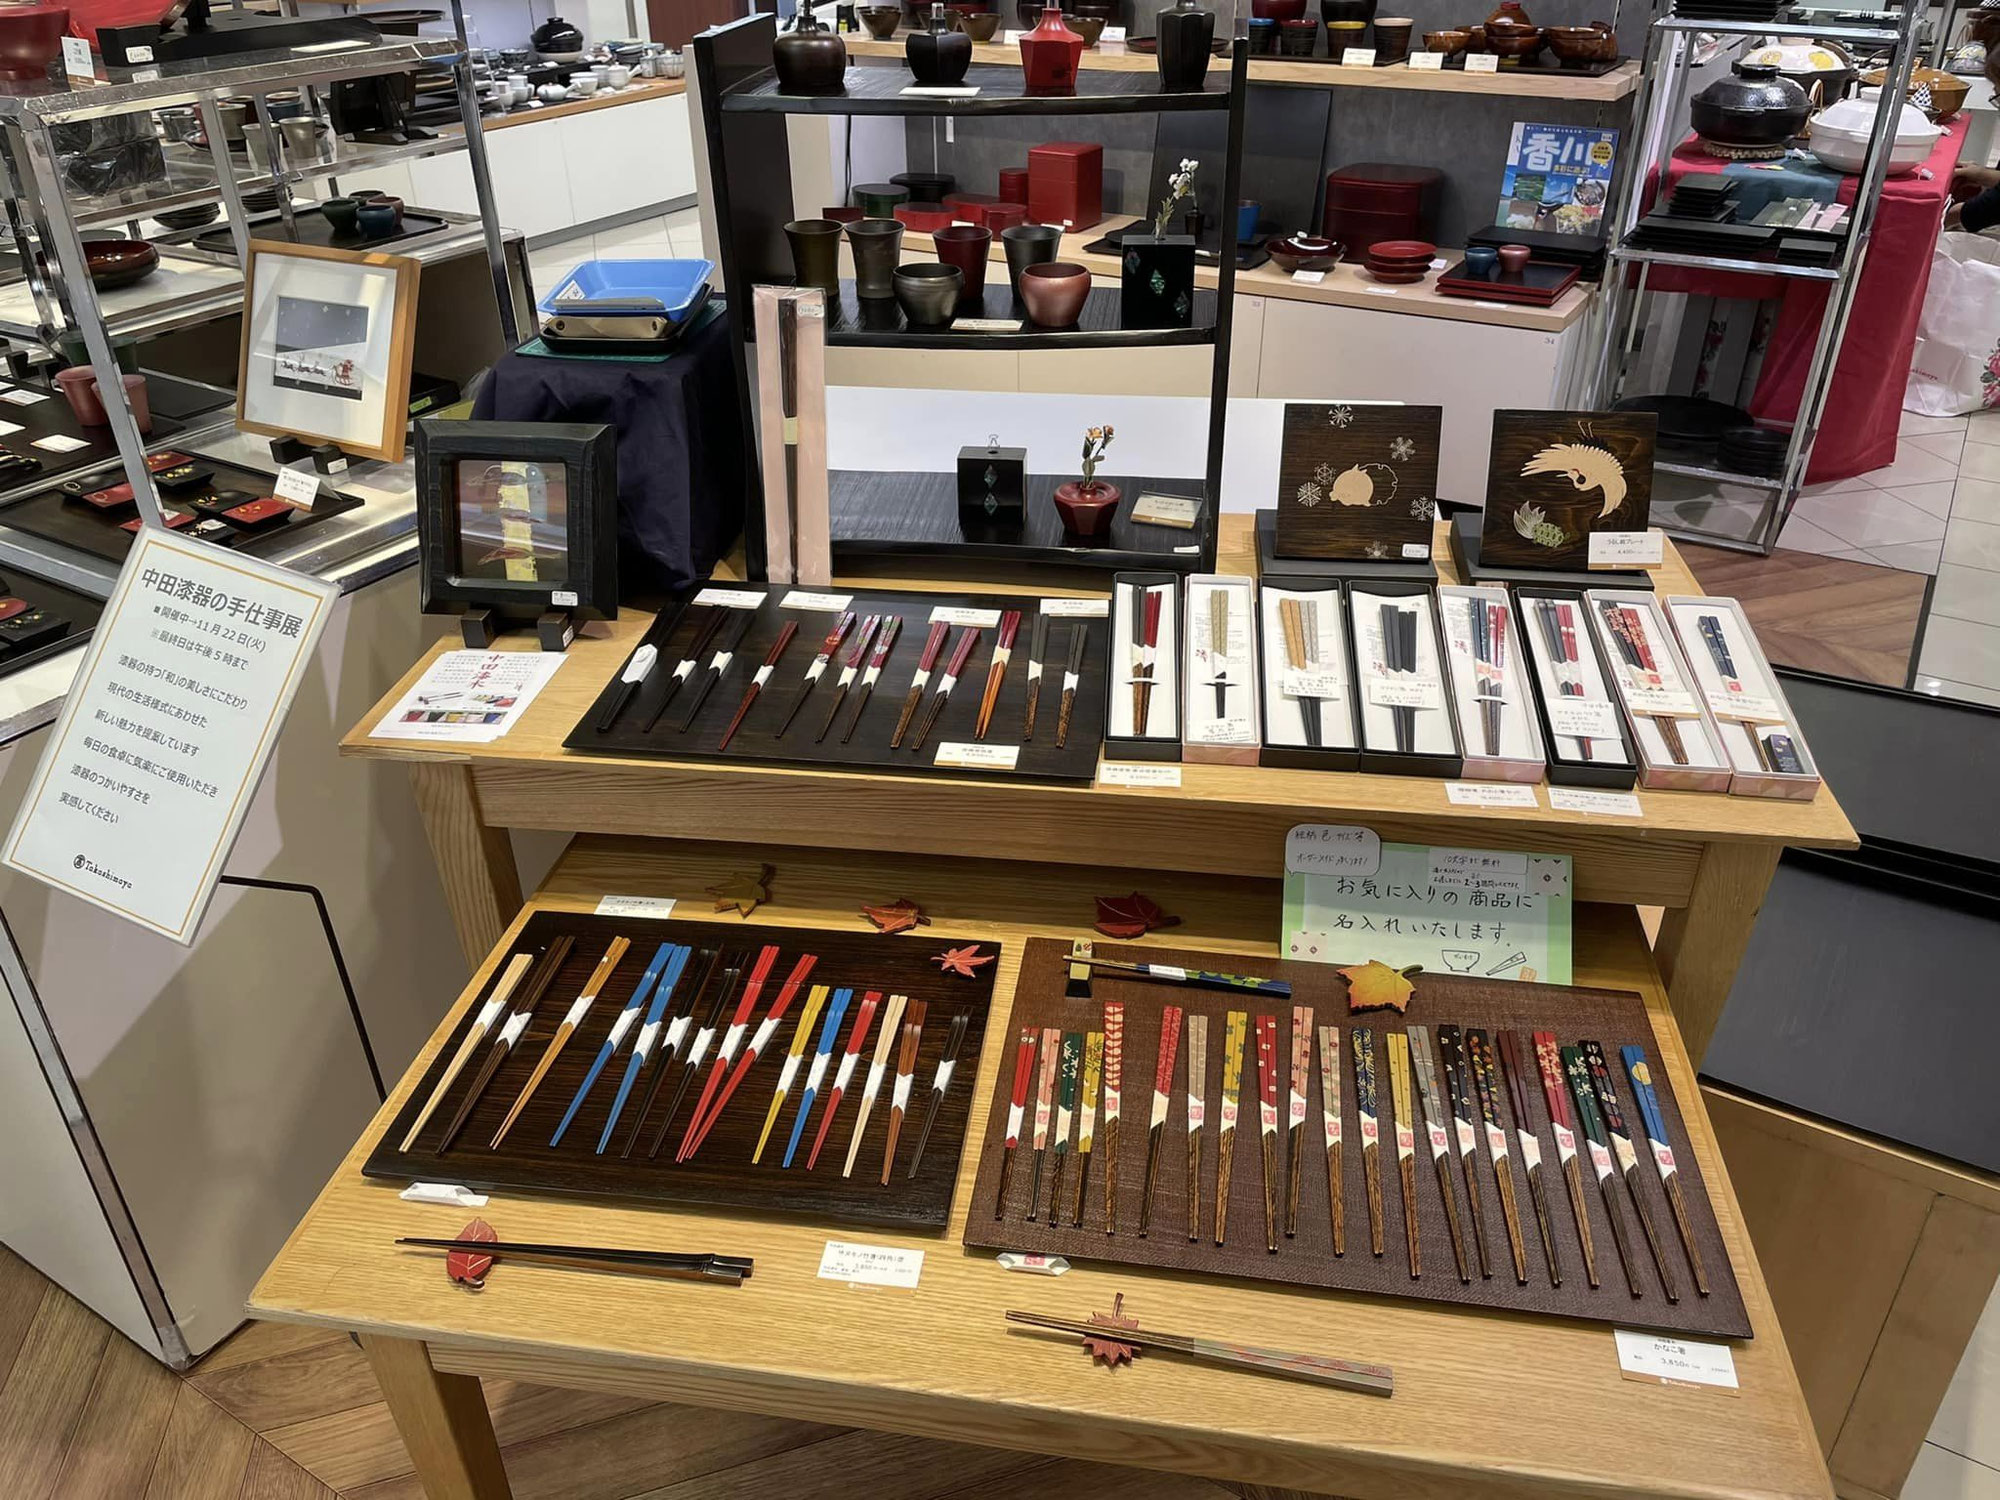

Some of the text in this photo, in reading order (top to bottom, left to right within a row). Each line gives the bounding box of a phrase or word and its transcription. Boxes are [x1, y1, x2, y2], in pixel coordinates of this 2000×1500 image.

[1522, 132, 1595, 171] 香川
[142, 568, 303, 638] 中田漆器の手仕事展
[107, 681, 208, 729] 現代の生活様式にあわせた
[118, 654, 248, 710] 漆器の持つ「和」の美しさにこだわり
[95, 709, 200, 757] 新しい魅力を提案しています
[71, 764, 151, 805] 漆器のつかいやすさを
[84, 736, 219, 798] 毎日の食卓に気楽にご使用いただき
[59, 791, 119, 824] 実感してください
[1334, 914, 1511, 948] 名入れいたします。
